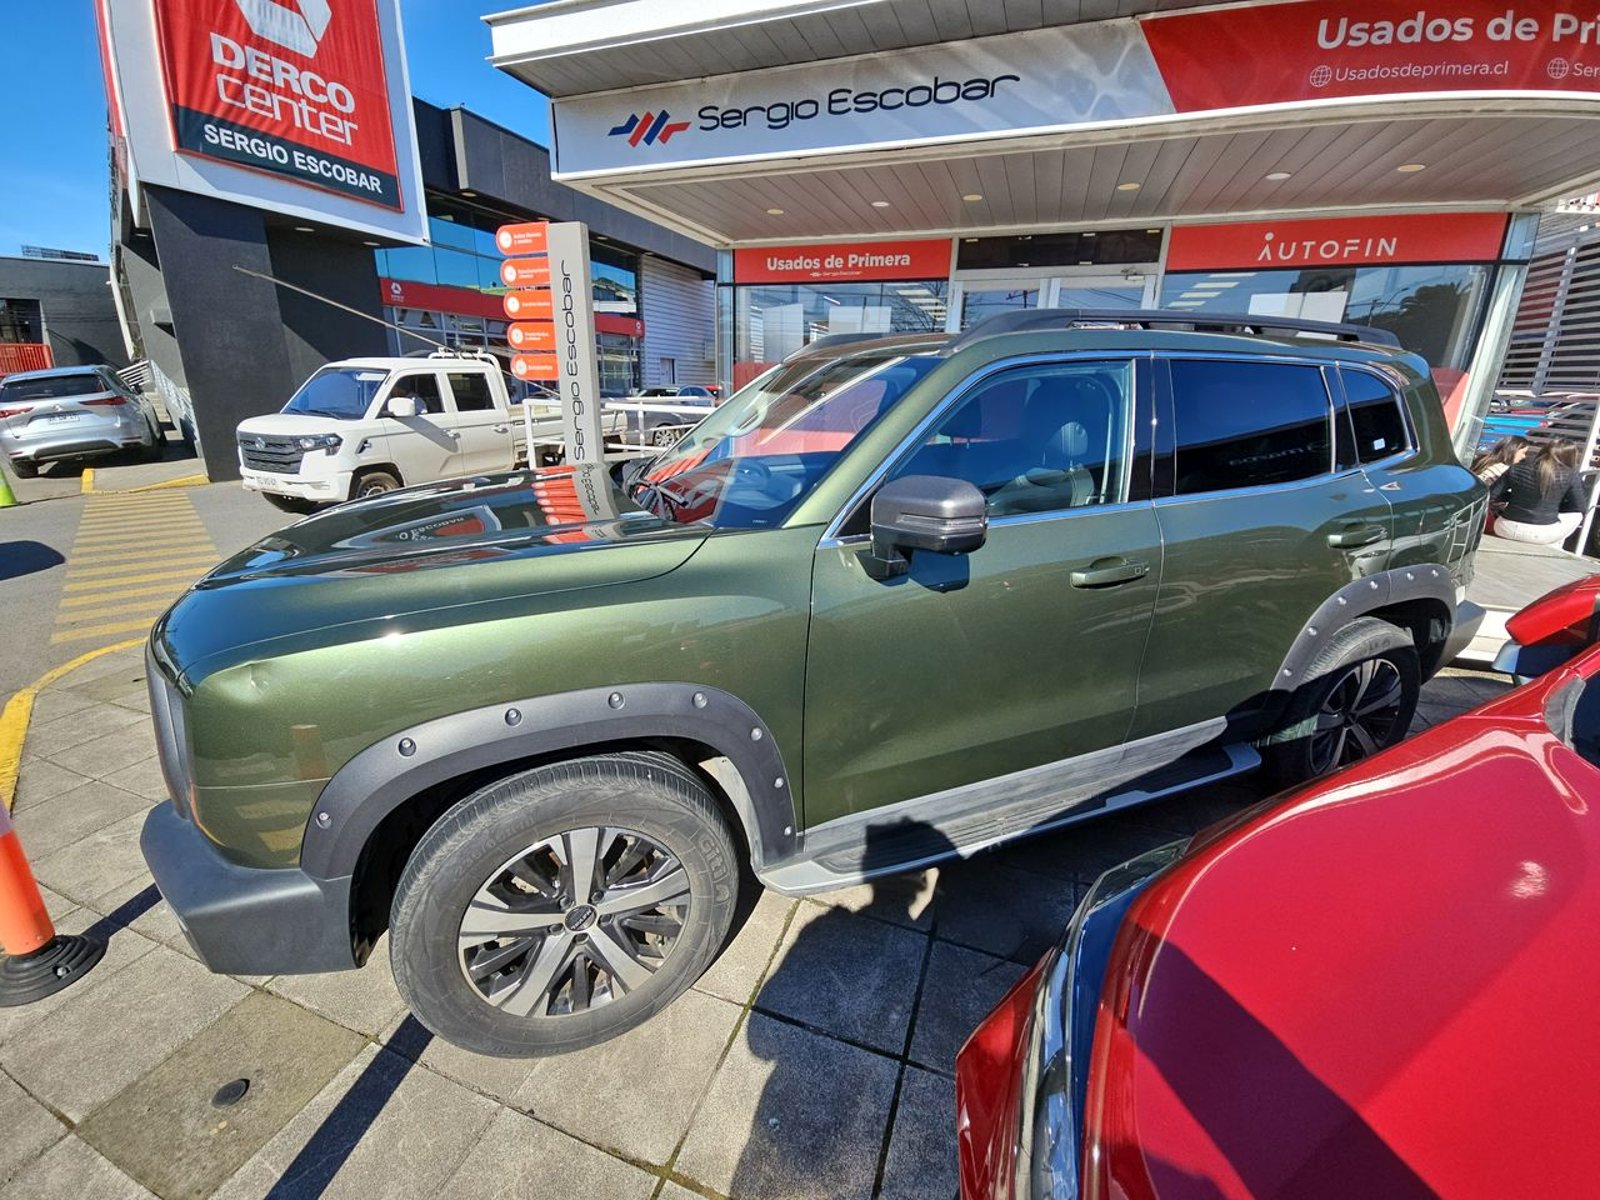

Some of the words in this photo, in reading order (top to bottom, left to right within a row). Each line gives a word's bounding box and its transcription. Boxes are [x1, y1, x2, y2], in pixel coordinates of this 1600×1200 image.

[1316, 10, 1474, 50] Usados
[1486, 9, 1539, 42] de
[209, 31, 355, 114] DERCO
[697, 99, 819, 131] Sergio
[827, 75, 1021, 116] Escobar
[1334, 60, 1509, 83] Usadosdeprimera.cl
[215, 73, 359, 146] center
[203, 124, 289, 164] SERGIO
[293, 150, 383, 194] ESCOBAR
[766, 256, 821, 271] Usados
[824, 254, 844, 269] de
[847, 252, 911, 268] Primera
[1256, 231, 1398, 262] AUTOFIN
[560, 259, 579, 377] Escobar
[570, 381, 585, 461] Sergio
